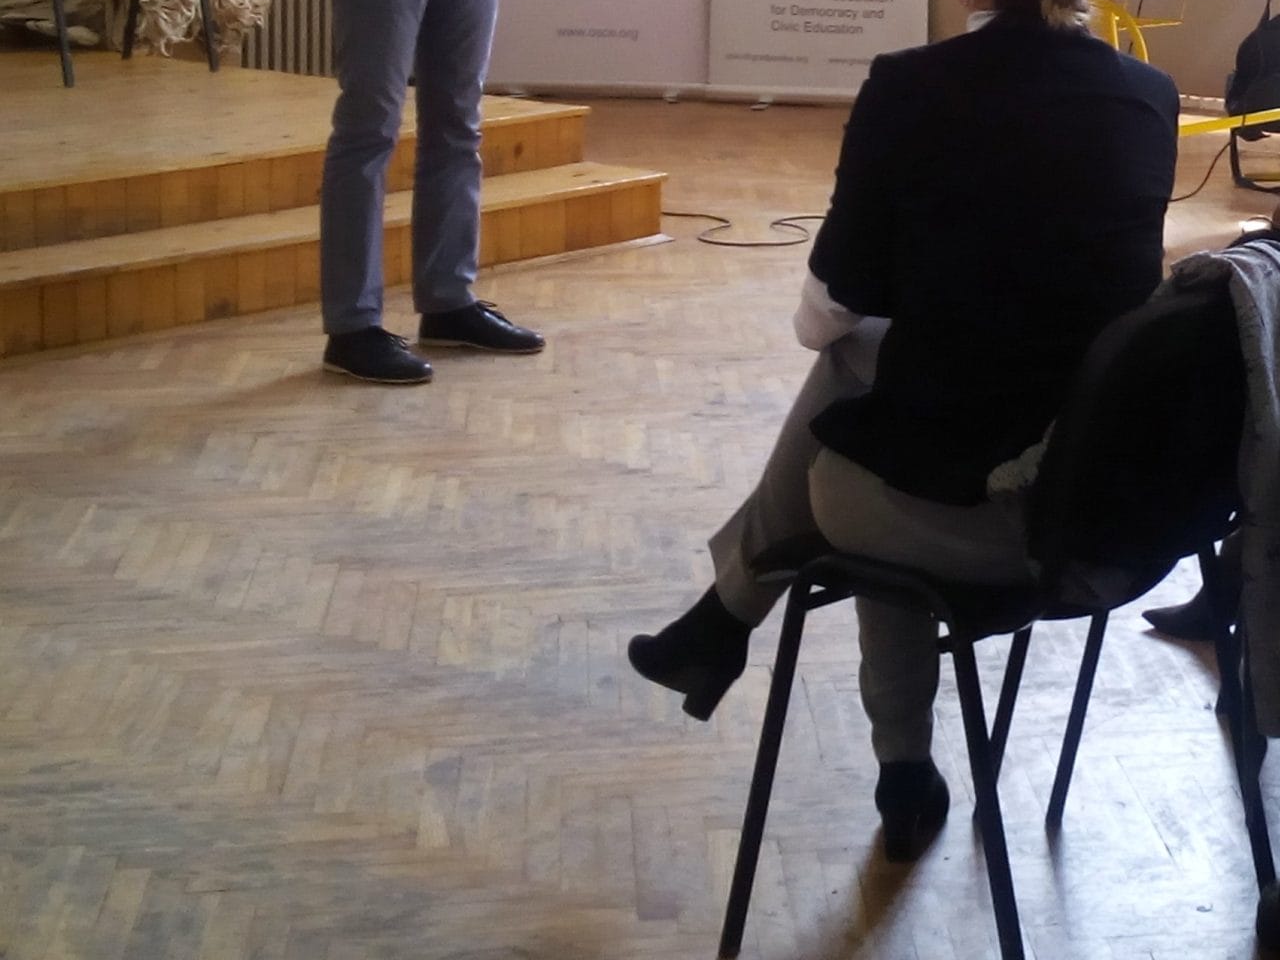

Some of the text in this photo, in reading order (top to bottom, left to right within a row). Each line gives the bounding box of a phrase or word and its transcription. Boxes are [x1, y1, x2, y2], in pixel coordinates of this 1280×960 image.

[771, 4, 884, 20] for Democracy and
[803, 21, 863, 34] Education
